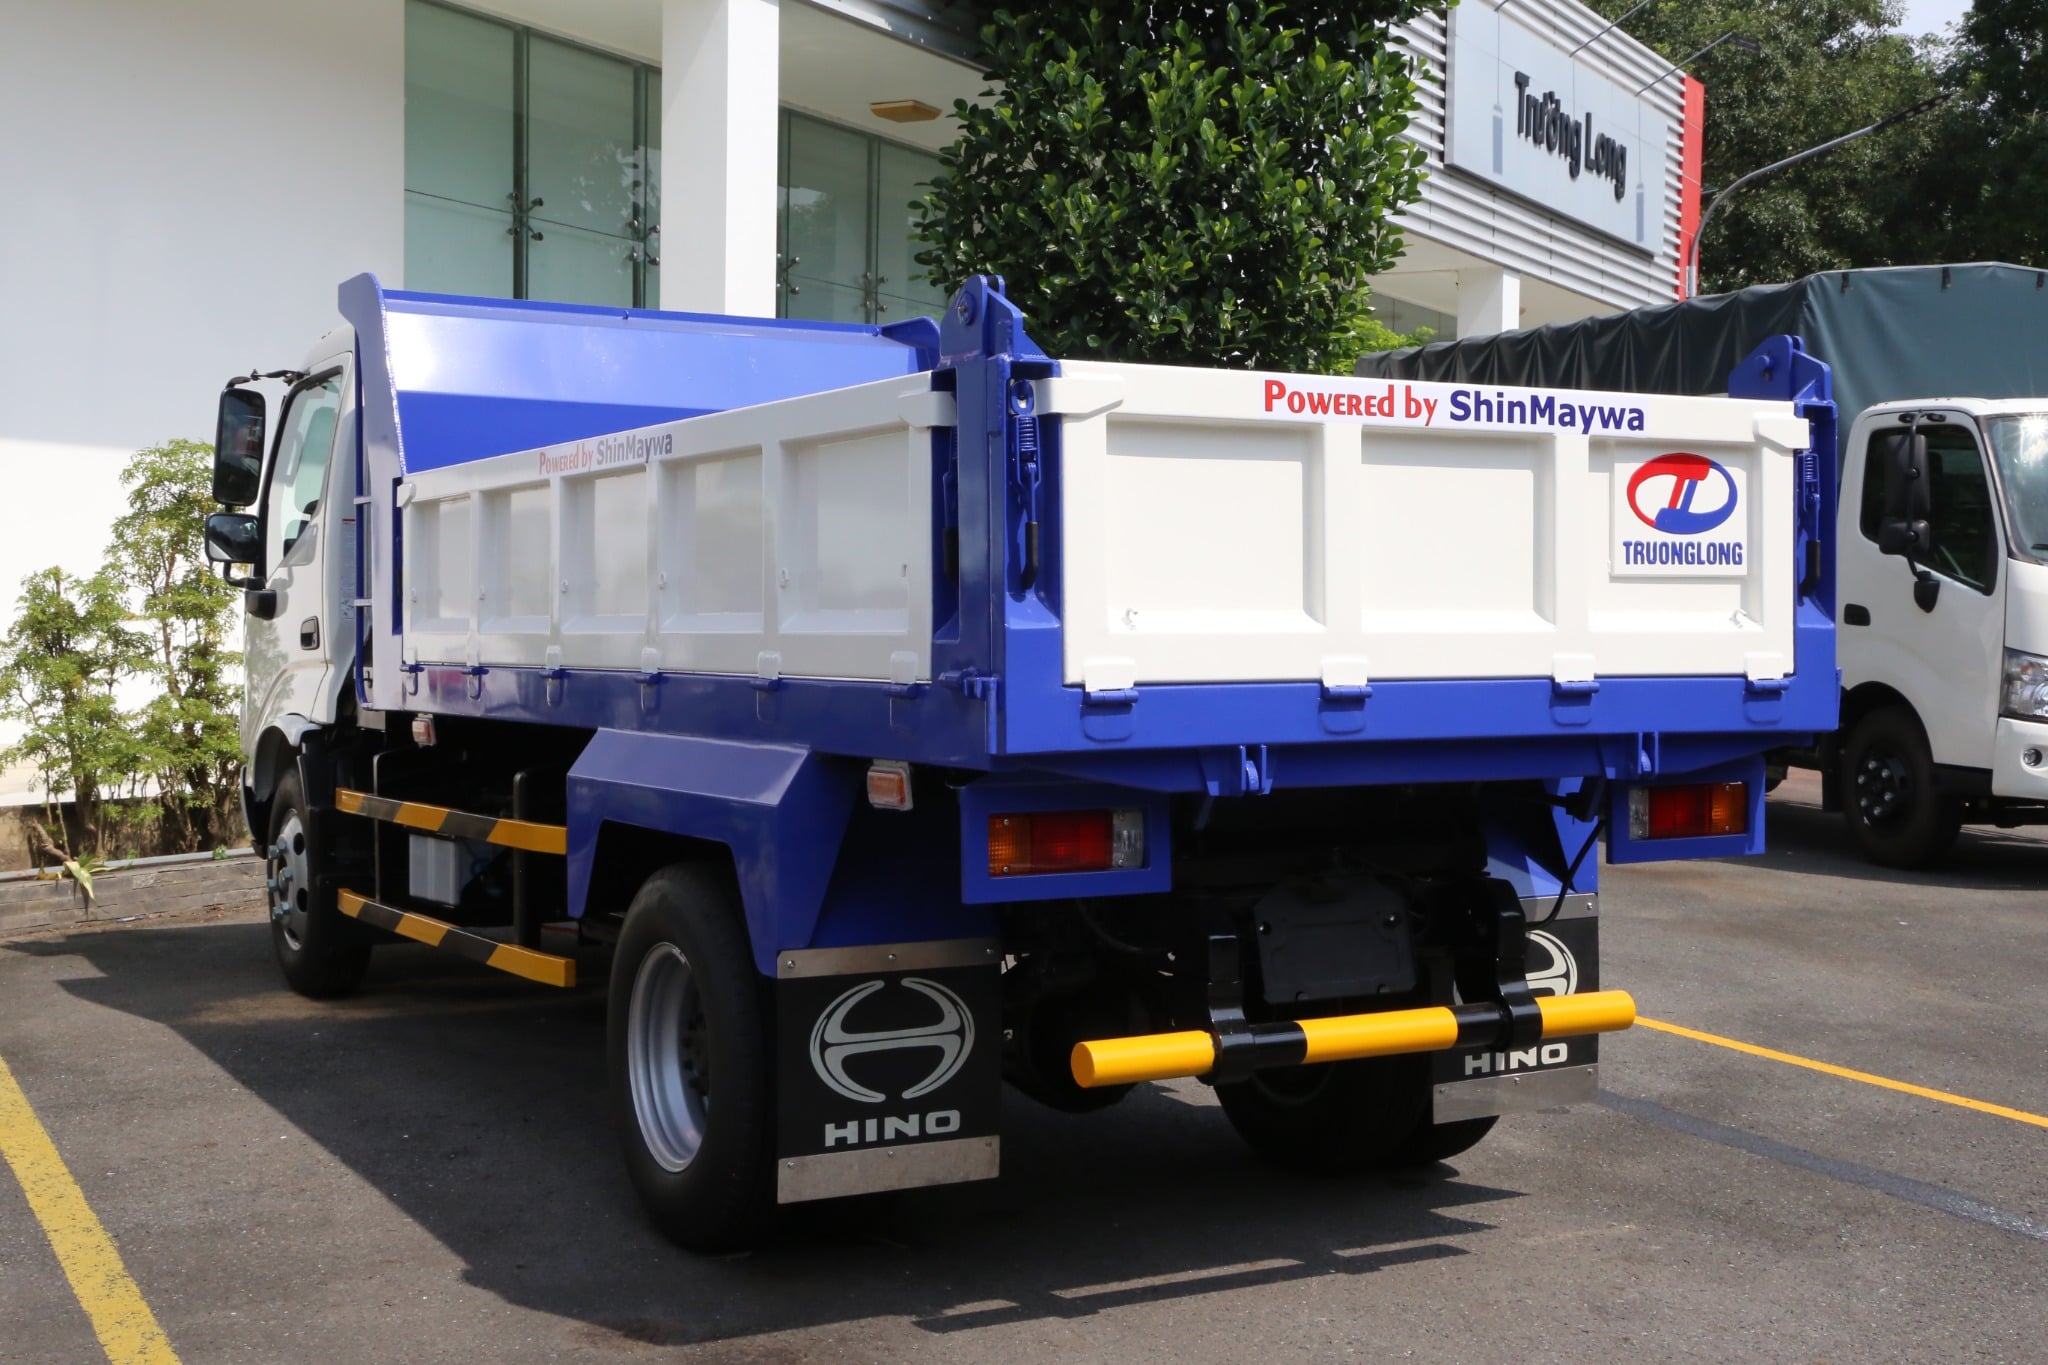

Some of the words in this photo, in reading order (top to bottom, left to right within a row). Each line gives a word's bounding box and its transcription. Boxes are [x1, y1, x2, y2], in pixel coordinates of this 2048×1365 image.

[1585, 112, 1627, 201] Long
[1405, 385, 1438, 427] by
[1450, 390, 1645, 434] ShinMaywa
[581, 442, 594, 472] by
[596, 433, 673, 463] ShinMaywa
[1623, 540, 1743, 565] TRUONGLONG
[1465, 1043, 1568, 1076] HINO
[825, 1109, 961, 1147] HINO
